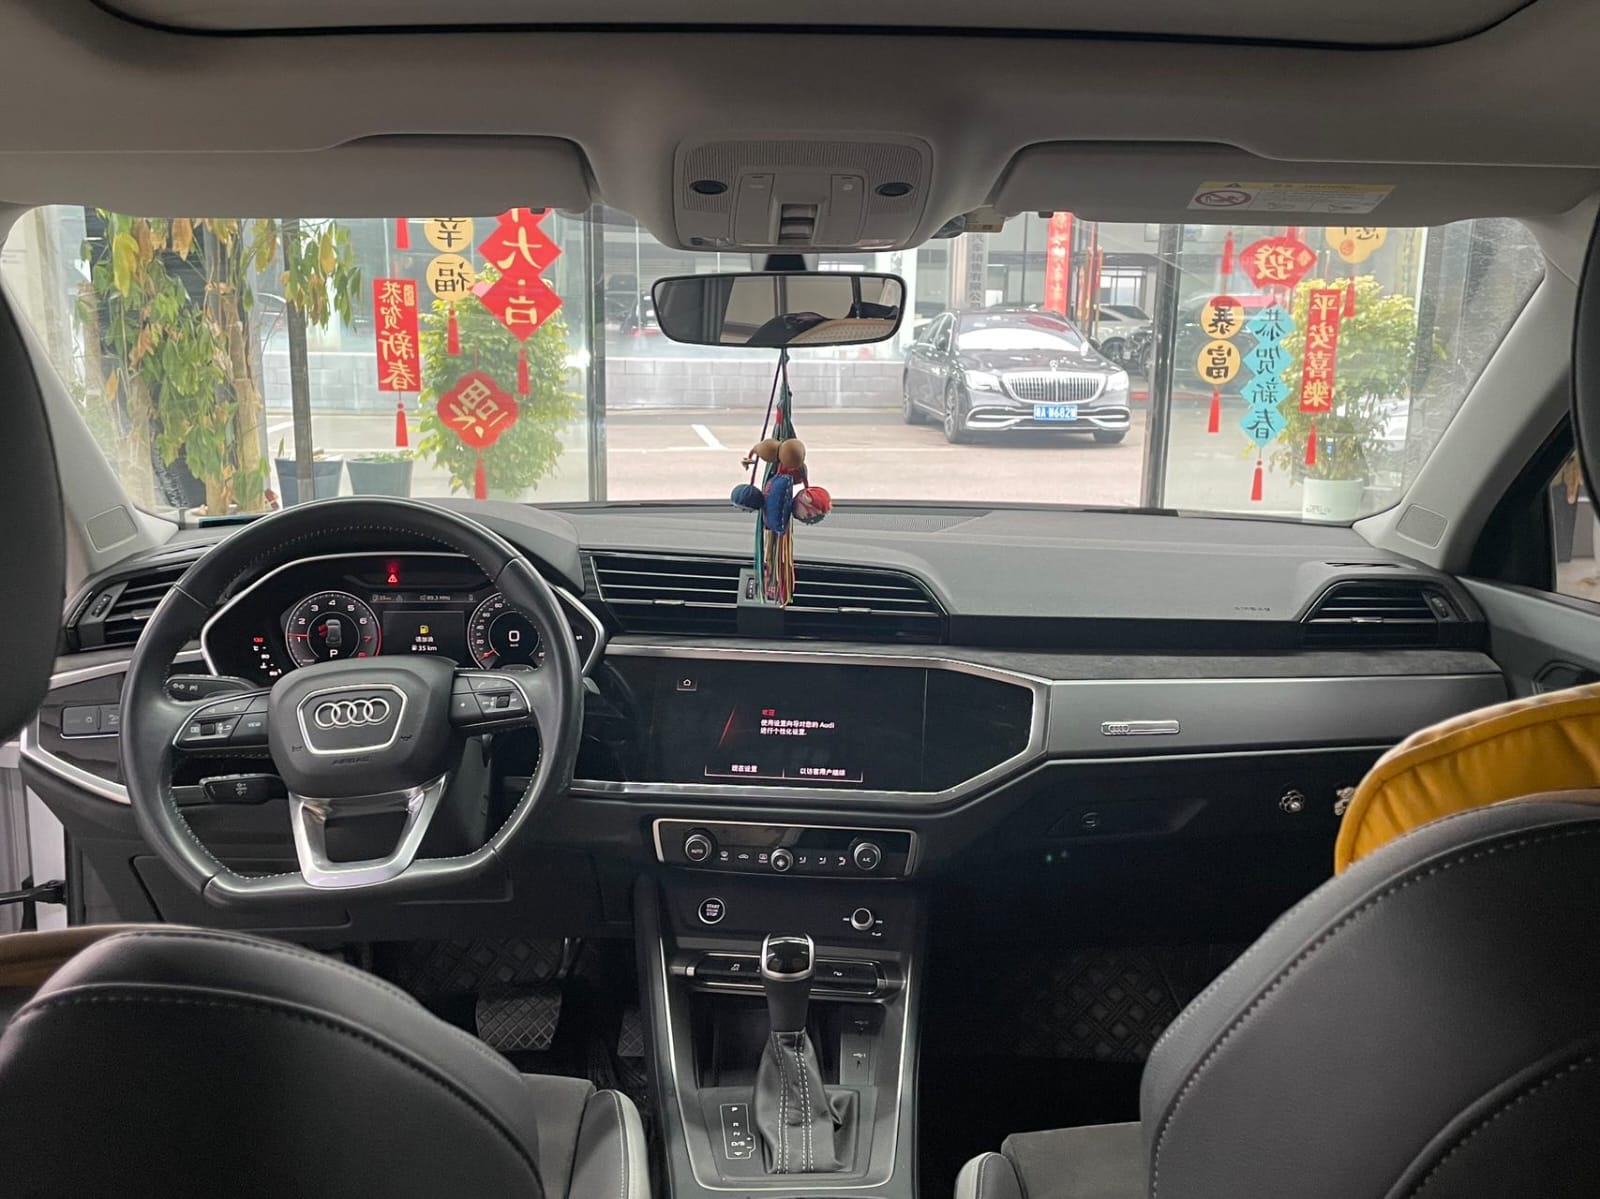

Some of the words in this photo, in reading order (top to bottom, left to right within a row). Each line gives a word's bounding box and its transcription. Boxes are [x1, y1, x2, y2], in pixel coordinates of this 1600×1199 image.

[311, 604, 319, 612] 3
[298, 617, 306, 625] 2
[359, 617, 367, 625] 6
[508, 630, 520, 642] 0
[329, 650, 338, 658] P
[820, 721, 835, 729] Audi
